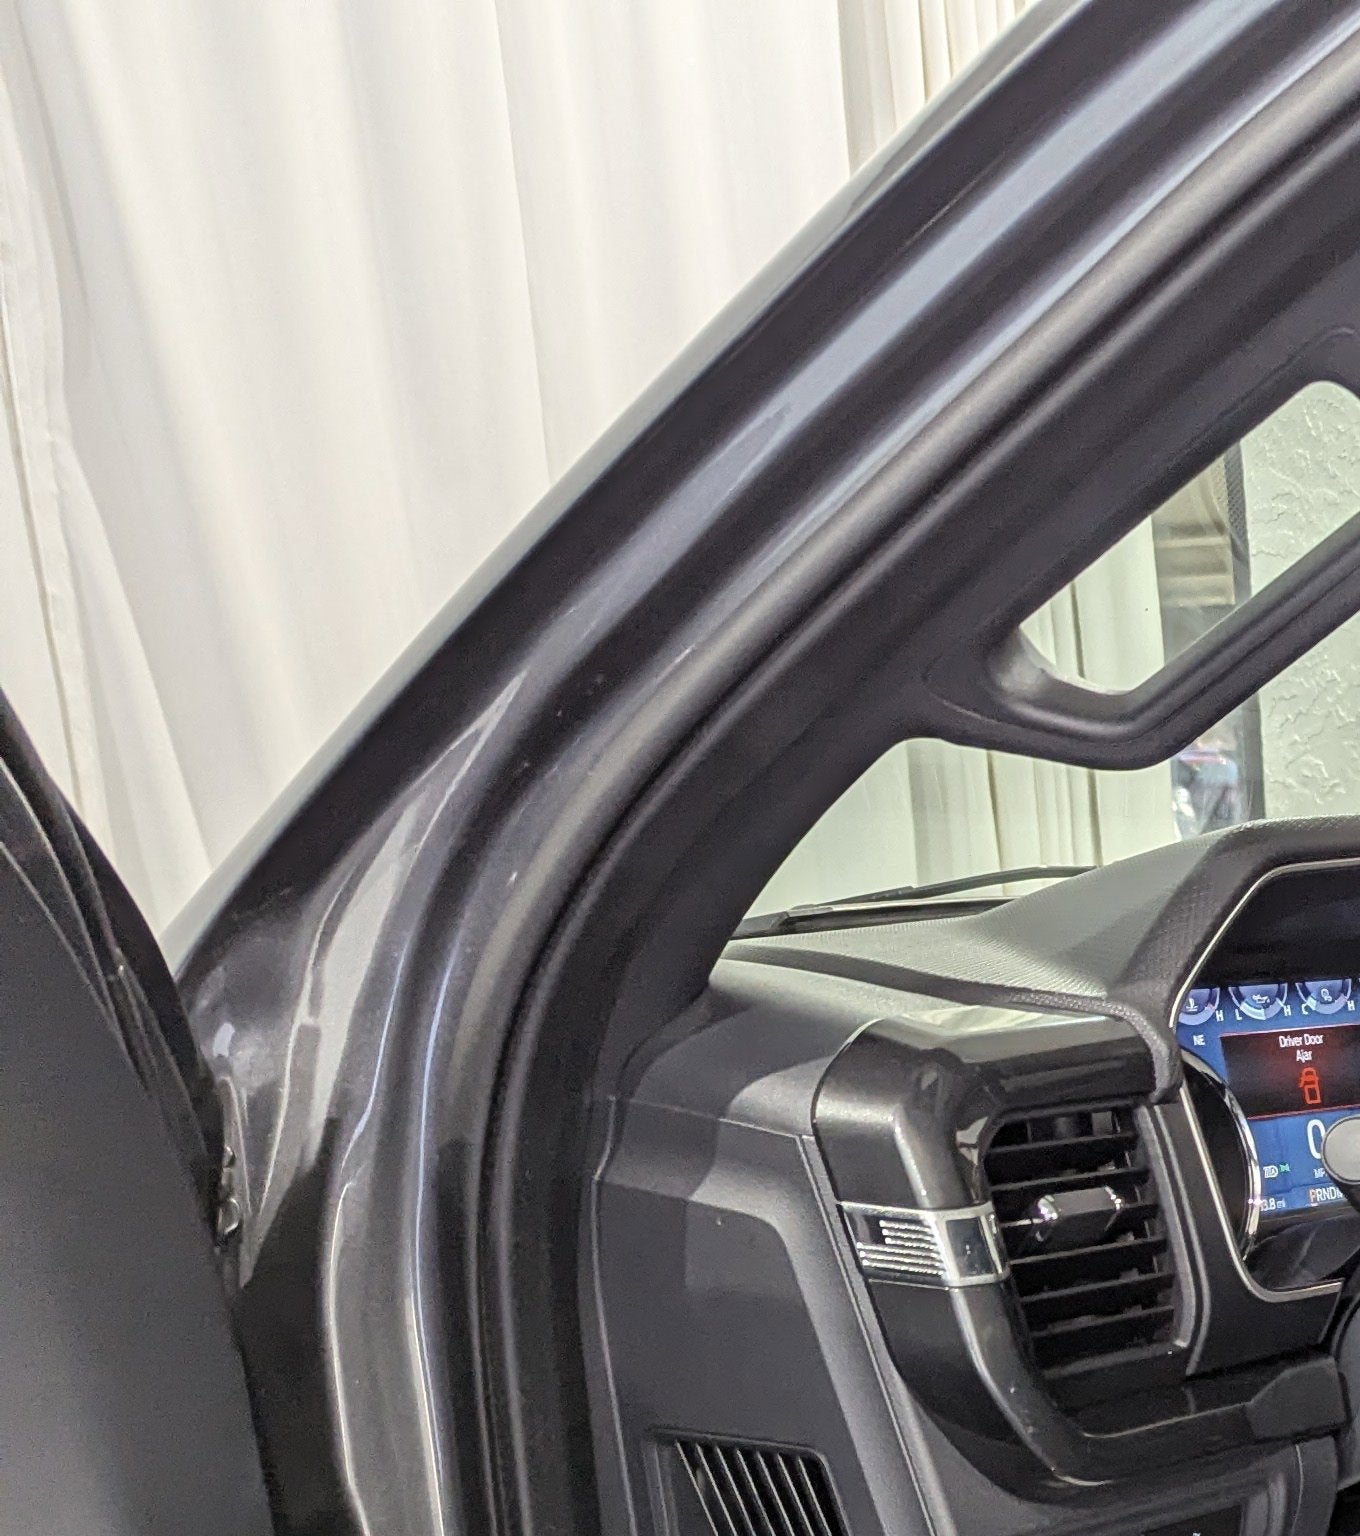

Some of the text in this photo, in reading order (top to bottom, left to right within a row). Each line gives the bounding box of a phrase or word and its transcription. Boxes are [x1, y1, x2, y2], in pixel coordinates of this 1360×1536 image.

[1193, 1035, 1206, 1046] NE
[1279, 1034, 1324, 1048] Driver Door
[1296, 1049, 1313, 1063] Ajar
